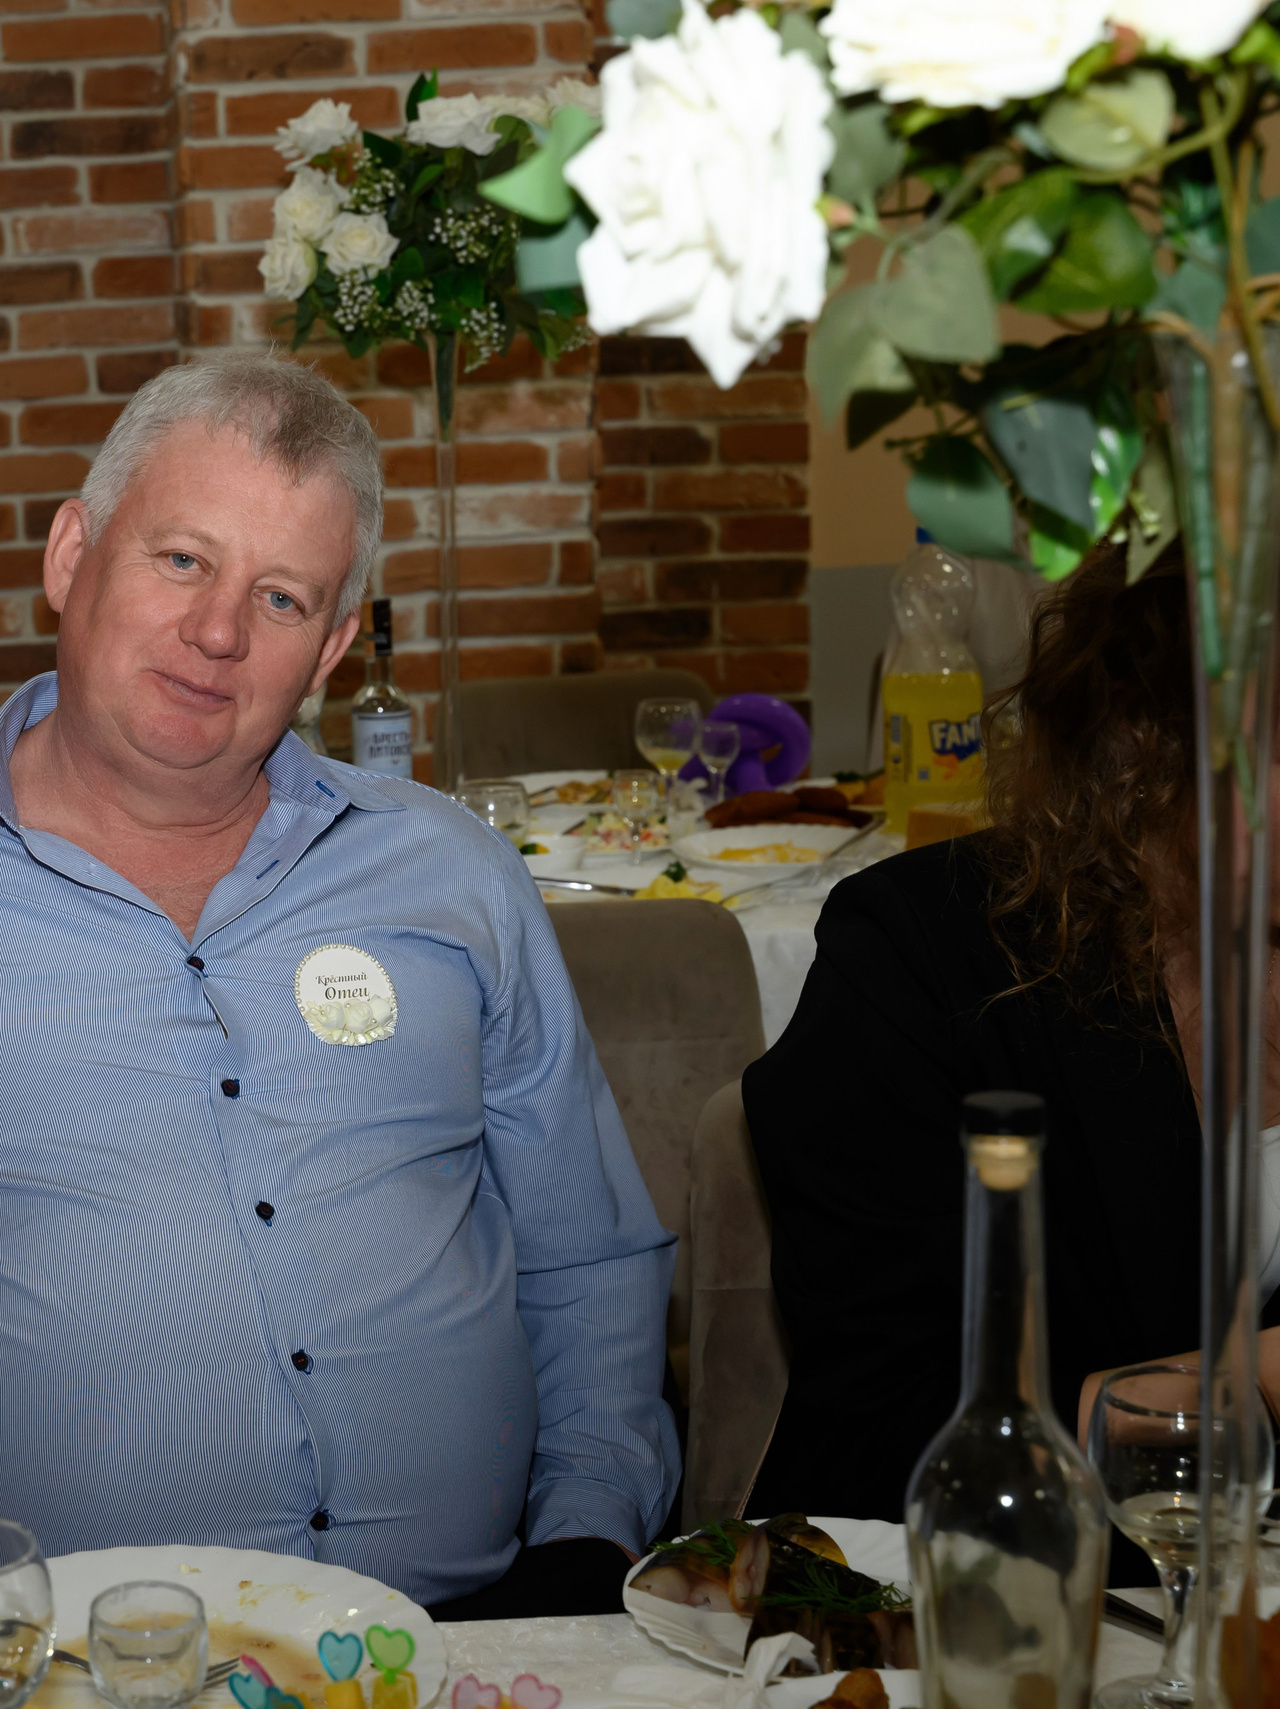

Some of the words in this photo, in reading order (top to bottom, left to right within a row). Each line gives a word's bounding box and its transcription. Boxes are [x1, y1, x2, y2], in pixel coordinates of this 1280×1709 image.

[931, 722, 980, 750] FAN
[315, 972, 368, 986] Крёстный
[325, 986, 370, 1001] Отец
